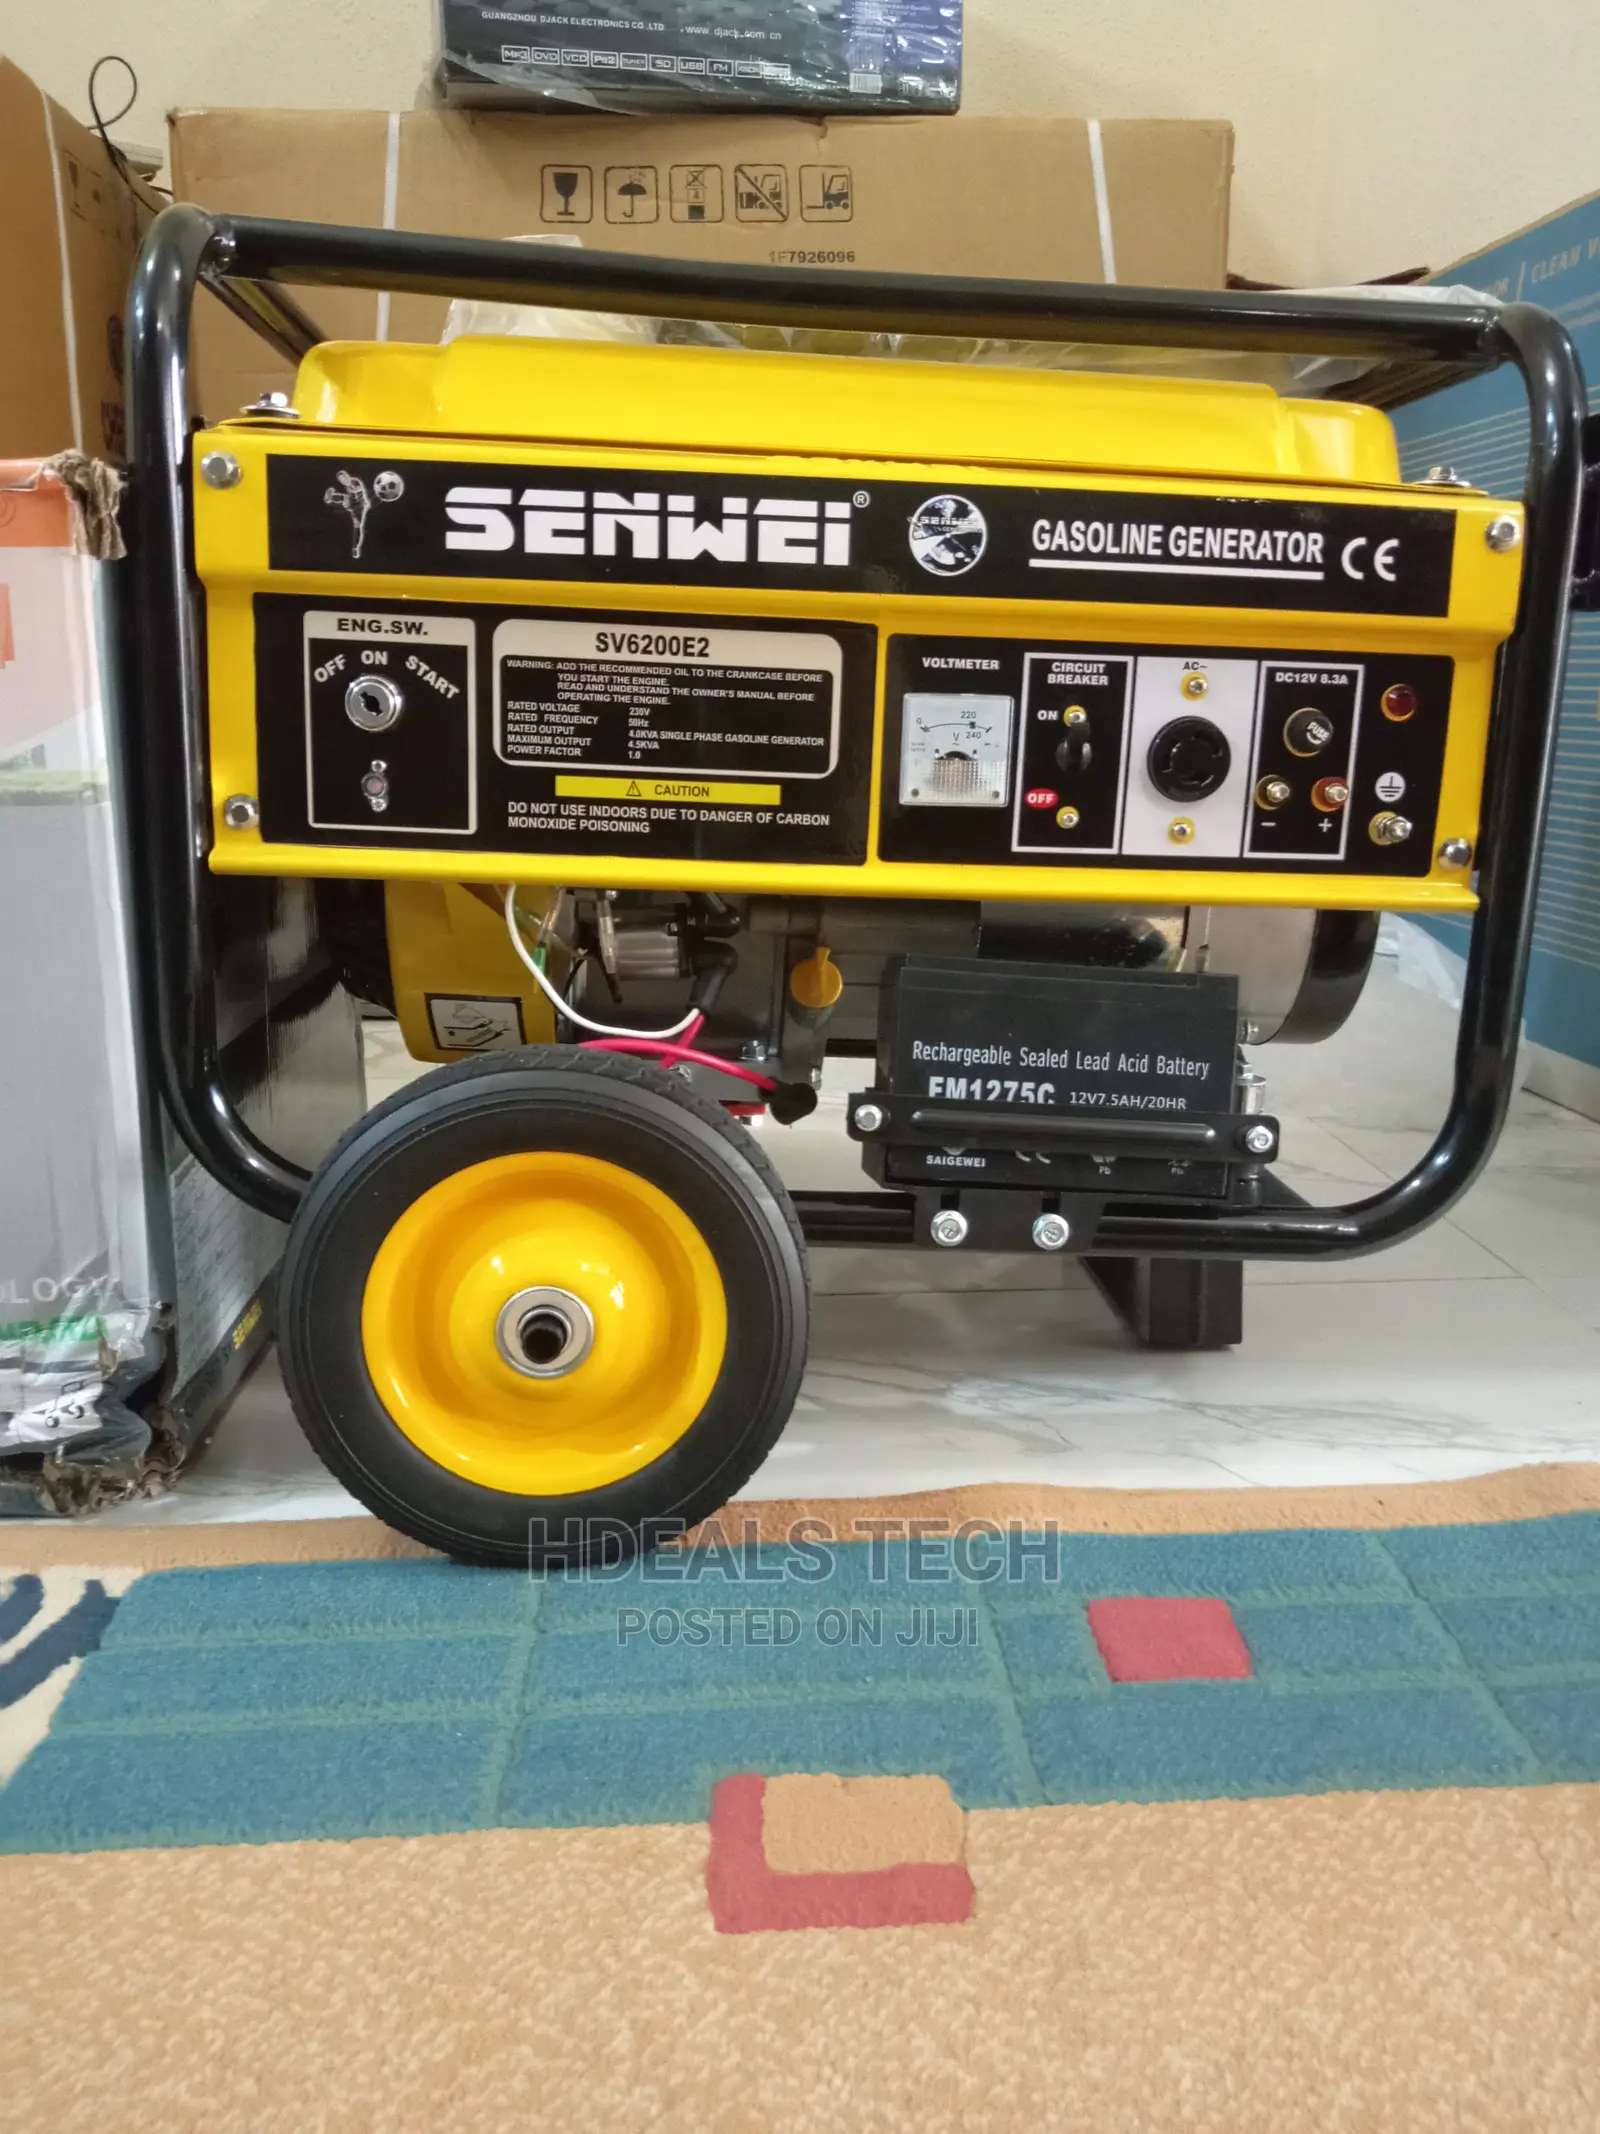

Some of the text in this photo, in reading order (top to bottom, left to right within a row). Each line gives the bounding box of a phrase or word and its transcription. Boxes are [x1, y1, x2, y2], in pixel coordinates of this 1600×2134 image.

[481, 11, 537, 22] GUANGZHOU
[540, 15, 569, 25] DJACK
[570, 17, 630, 29] ELECTRONICS
[534, 52, 558, 61] DVD
[565, 53, 588, 63] VCD
[654, 60, 671, 68] SD
[681, 62, 704, 70] USB
[713, 63, 728, 72] FM
[445, 486, 851, 566] SENWEI
[1031, 518, 1324, 564] GASOLINE GENERATOR
[1341, 537, 1399, 582] CE
[336, 618, 428, 636] ENG.SW.
[595, 632, 709, 658] SV6200E2
[360, 650, 388, 665] ON
[921, 657, 1000, 670] VOLTMETER
[313, 653, 347, 683] OFF
[506, 659, 823, 682] WARNING: ADD THE RECOMMENDED OIL TO THE CRANKCASE BEFORE
[1051, 662, 1106, 674] CIRCUIT
[405, 655, 460, 699] START
[557, 673, 578, 682] YOU
[580, 673, 609, 683] START
[612, 675, 630, 684] THE
[1047, 673, 1109, 686] BREAKER
[1275, 672, 1349, 685] DC12V 8.3A
[557, 682, 815, 701] READ AND UNDERSTAND THE OWNER'S MANUAL BEFORE
[557, 692, 610, 702] OPERATING
[613, 693, 631, 702] THE
[507, 701, 580, 713] RATED VOLTAGE
[629, 707, 650, 716] 230V
[507, 712, 599, 725] RATED FREQUENCY
[960, 711, 976, 719] 220
[1037, 710, 1058, 721] ON
[628, 718, 649, 727] 50Hz
[507, 724, 575, 735] RATED OUTPUT
[965, 731, 982, 740] 240
[1306, 721, 1330, 741] FUSE
[507, 735, 592, 746] MAXIMUM OUTPUT
[660, 731, 692, 741] SINGLE
[693, 732, 723, 742] PHASE
[725, 733, 769, 744] GASOLINE
[771, 736, 824, 746] GENERATOR
[507, 745, 582, 756] POWER FACTOR
[628, 741, 660, 750] 4.5KVA
[628, 751, 641, 759] 1.0
[654, 784, 710, 797] CAUTION
[1027, 792, 1054, 804] OFF
[507, 801, 831, 826] DO NOT USE INDOORS DUE TO DANGER OF CARBON
[507, 816, 650, 833] MONOXIDE POISONING
[912, 1040, 1210, 1080] Rechargeable Sealed Lead Acid Battery
[1069, 1091, 1186, 1110] 12V7.5AH/20HR
[926, 1155, 986, 1167] SAIGEWEI
